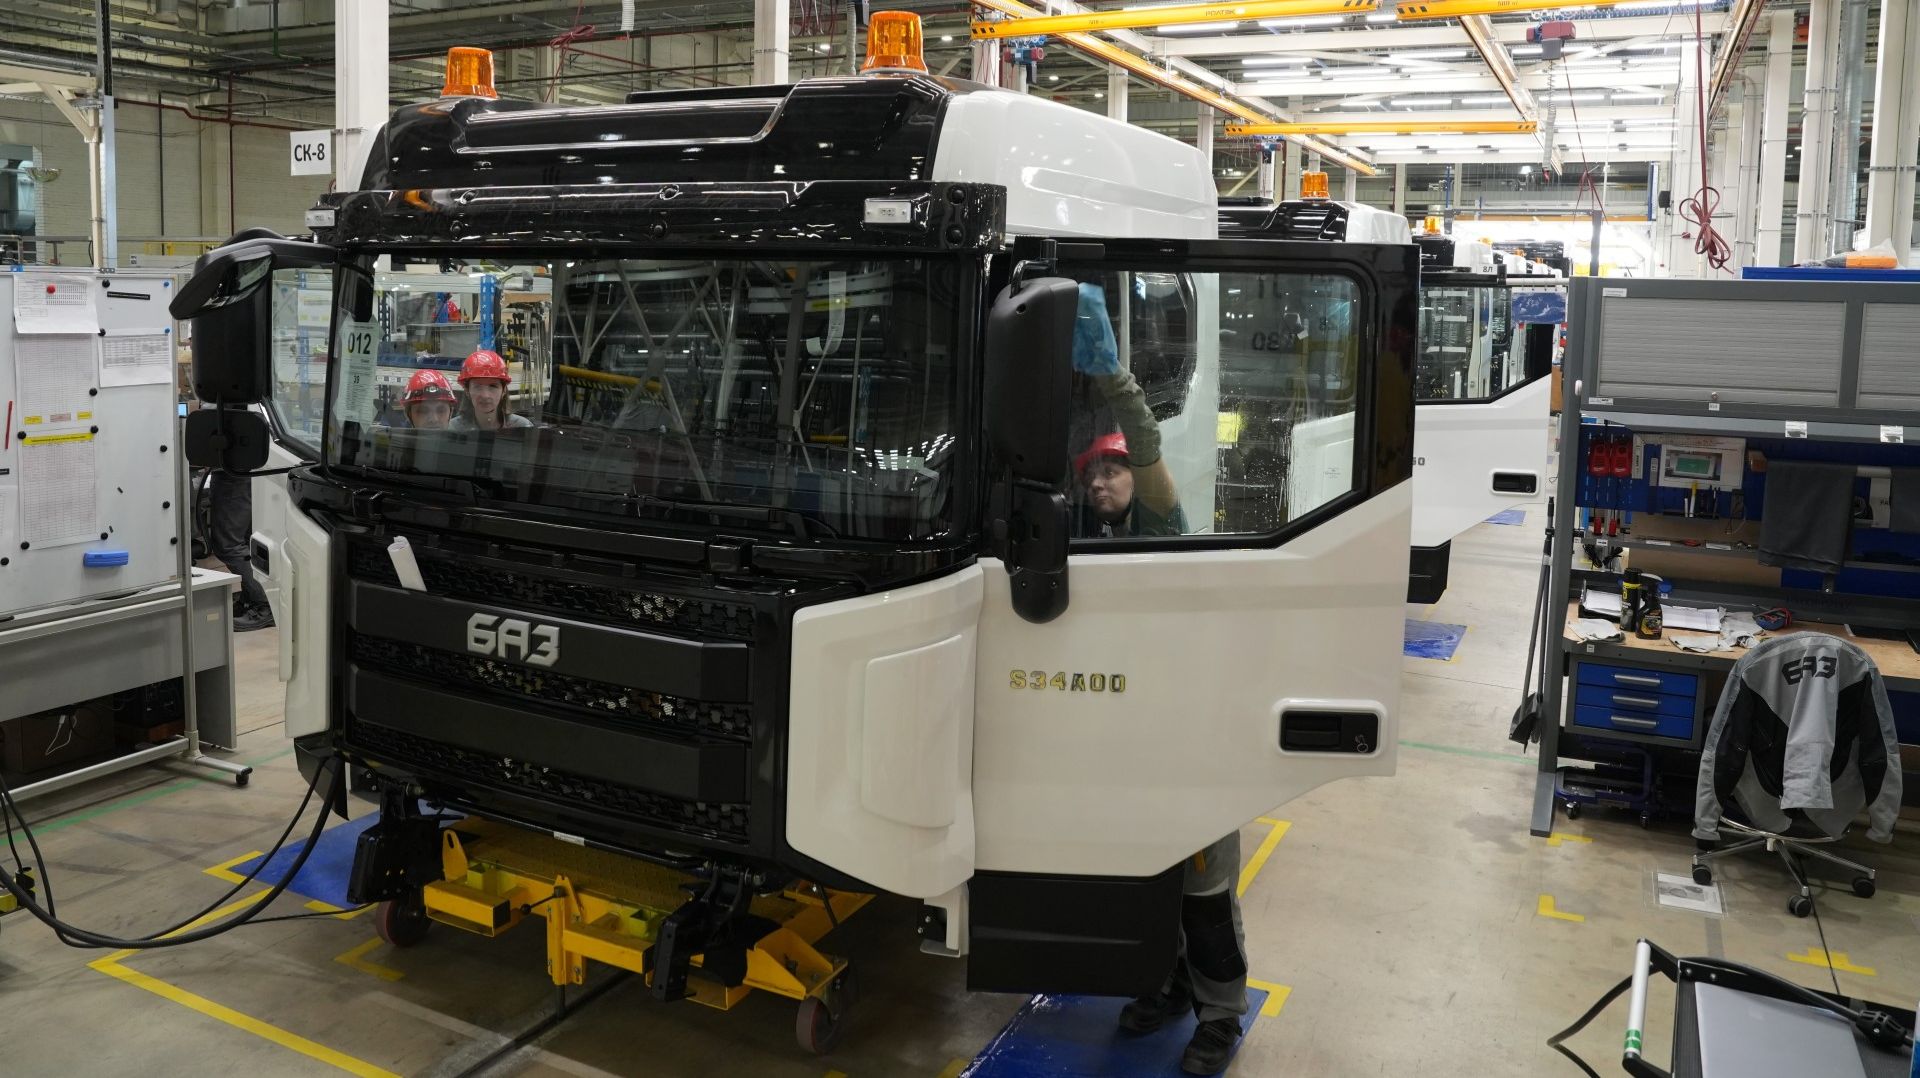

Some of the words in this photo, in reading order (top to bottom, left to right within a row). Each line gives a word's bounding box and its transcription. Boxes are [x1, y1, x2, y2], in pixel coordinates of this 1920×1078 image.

[294, 143, 325, 162] СК-8
[348, 333, 371, 354] 012
[1009, 669, 1126, 693] S34A00
